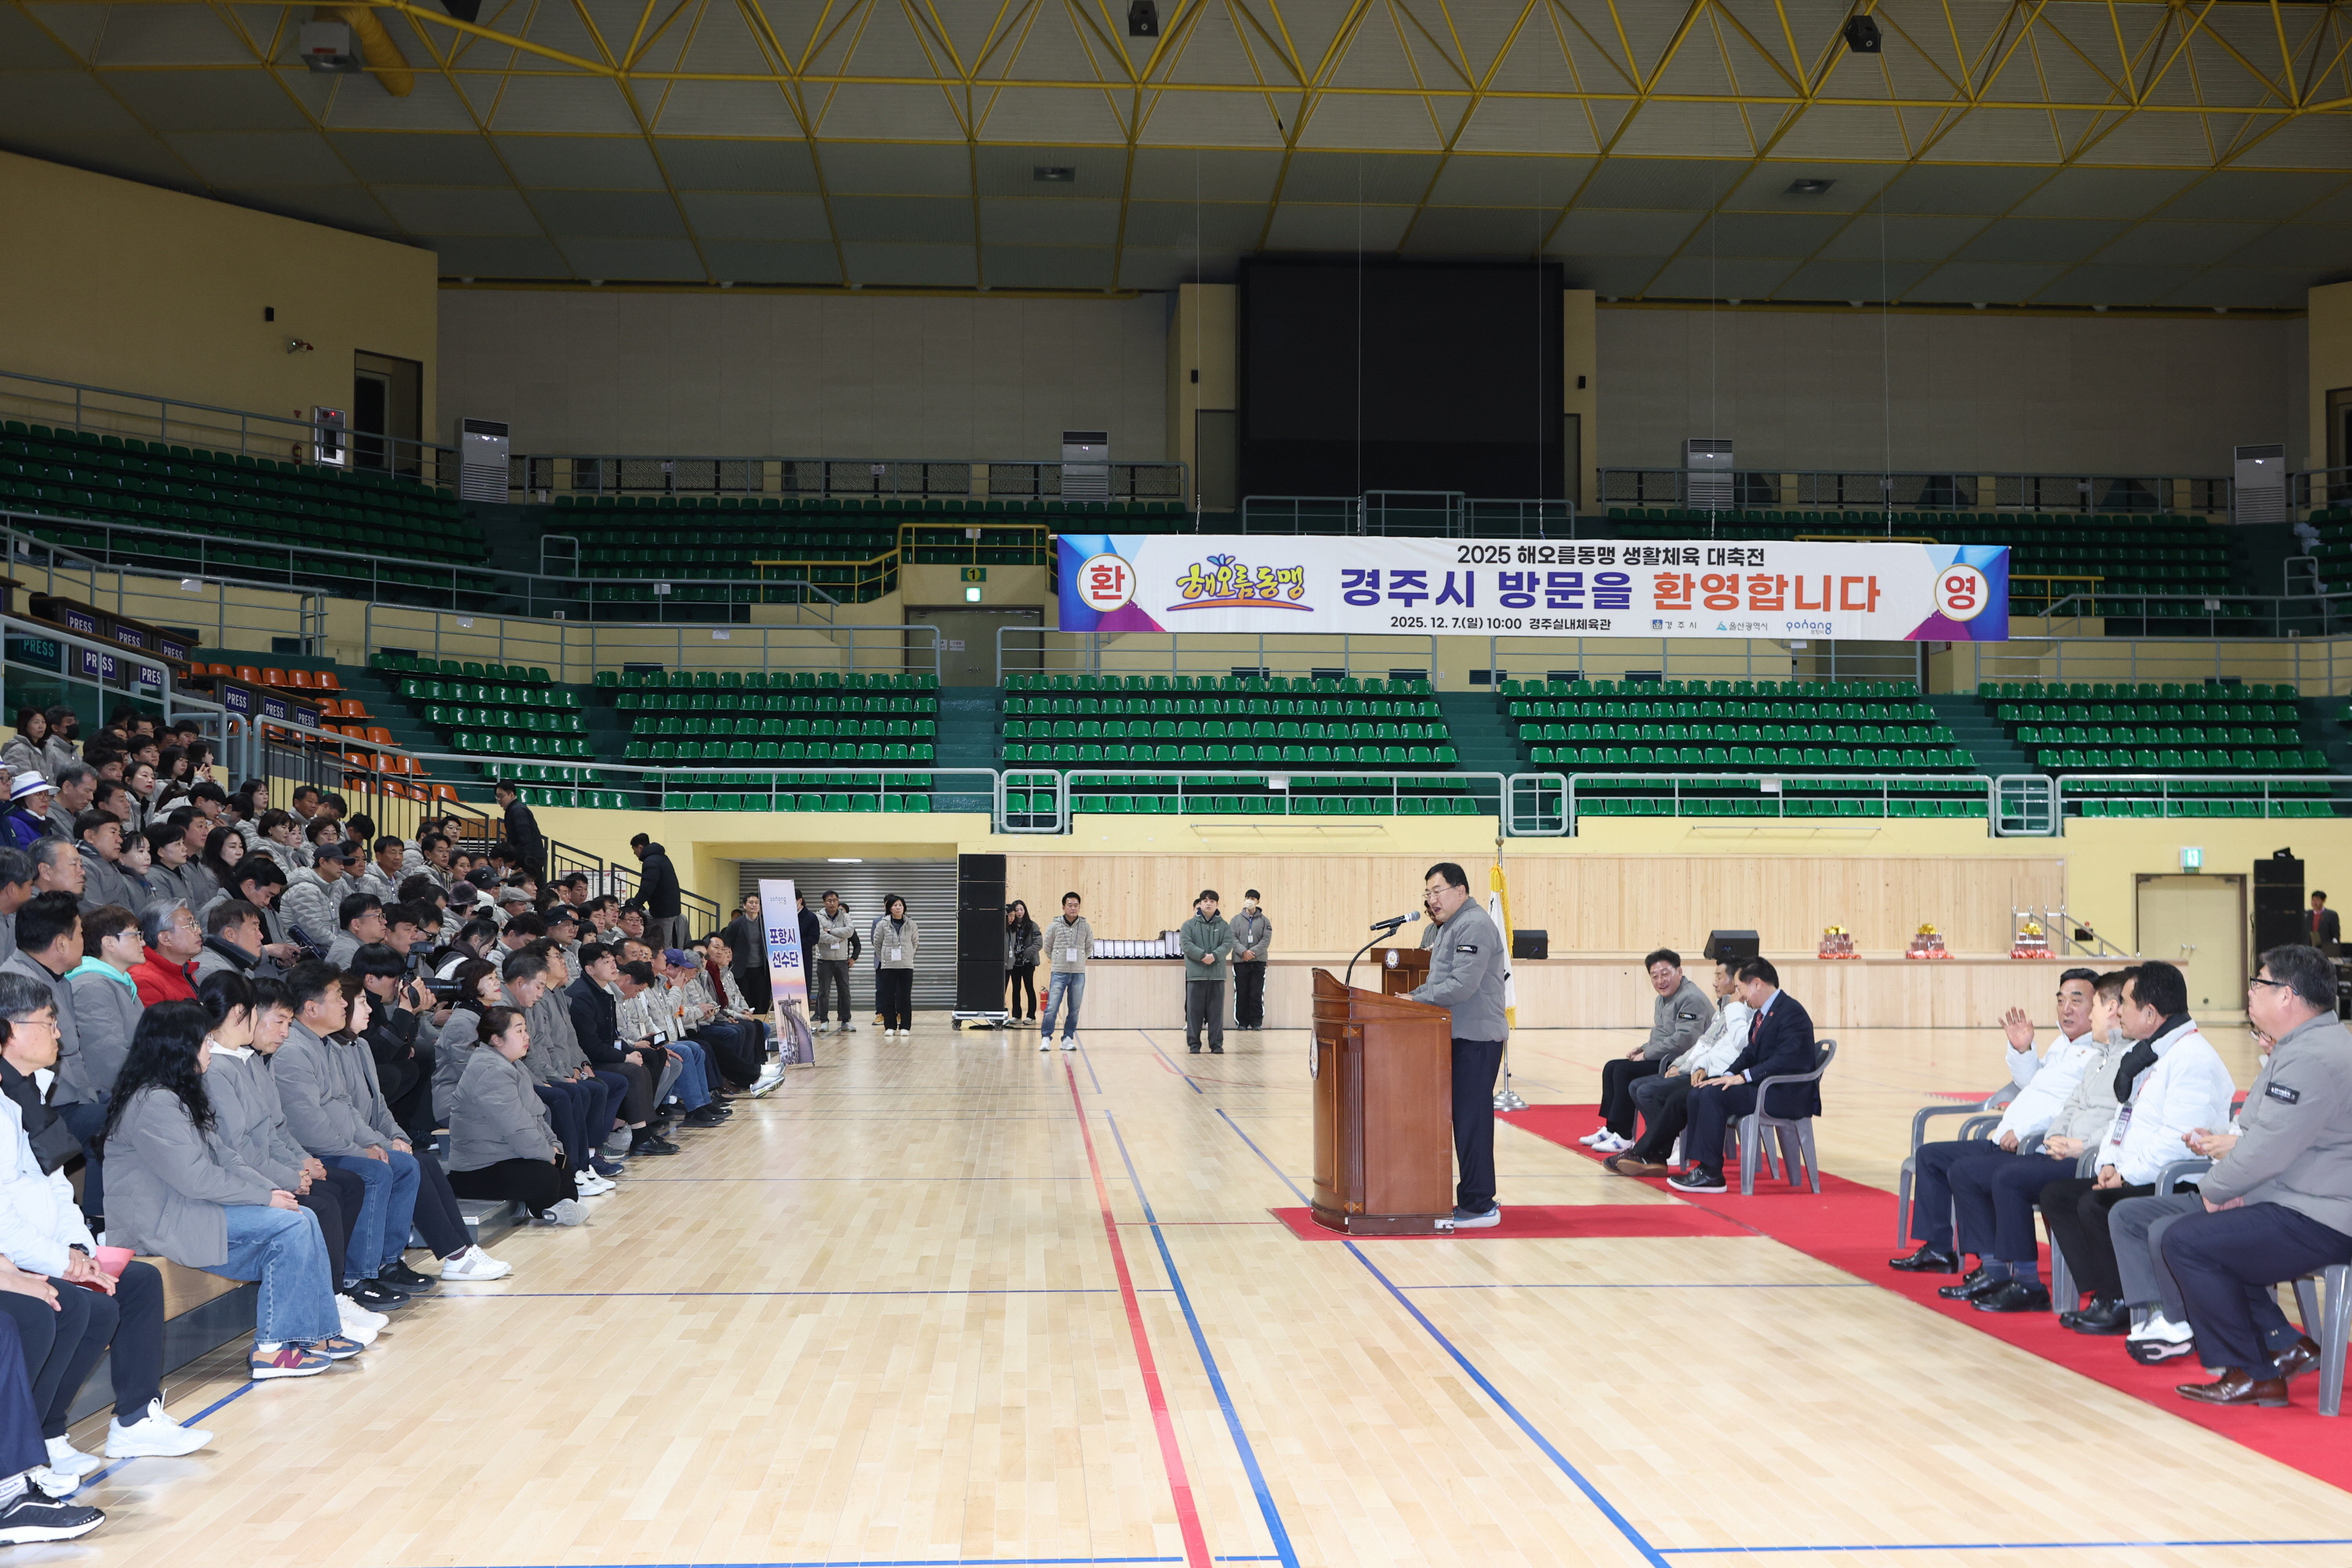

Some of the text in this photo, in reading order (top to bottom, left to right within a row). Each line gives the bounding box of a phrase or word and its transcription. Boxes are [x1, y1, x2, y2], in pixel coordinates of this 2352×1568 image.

[1457, 545, 1765, 567] 2025 해오름동맹 생활체육 대축전
[970, 569, 975, 580] 1
[1090, 564, 1125, 601] 환
[1176, 563, 1305, 600] 해오름동맹
[1341, 568, 1881, 612] 경주시 방문을 환영합니다
[1944, 575, 1976, 610] 영
[70, 616, 93, 633] PRESS
[1390, 616, 1427, 628] 2025.
[1431, 617, 1448, 629] 12.
[1486, 618, 1523, 630] 10:00
[1530, 619, 1611, 630] 경주실내체육관
[1729, 622, 1768, 631] 울산광역시
[24, 639, 55, 658] PRESS
[119, 633, 141, 648] PRESS
[164, 647, 183, 660] PRESS
[85, 652, 113, 673] PRSS
[142, 667, 162, 684] PRES
[227, 691, 247, 709] PRESS
[266, 703, 284, 719] PRESS
[298, 713, 314, 728] PRESS
[769, 927, 797, 945] 포항시
[772, 951, 799, 968] 선수단
